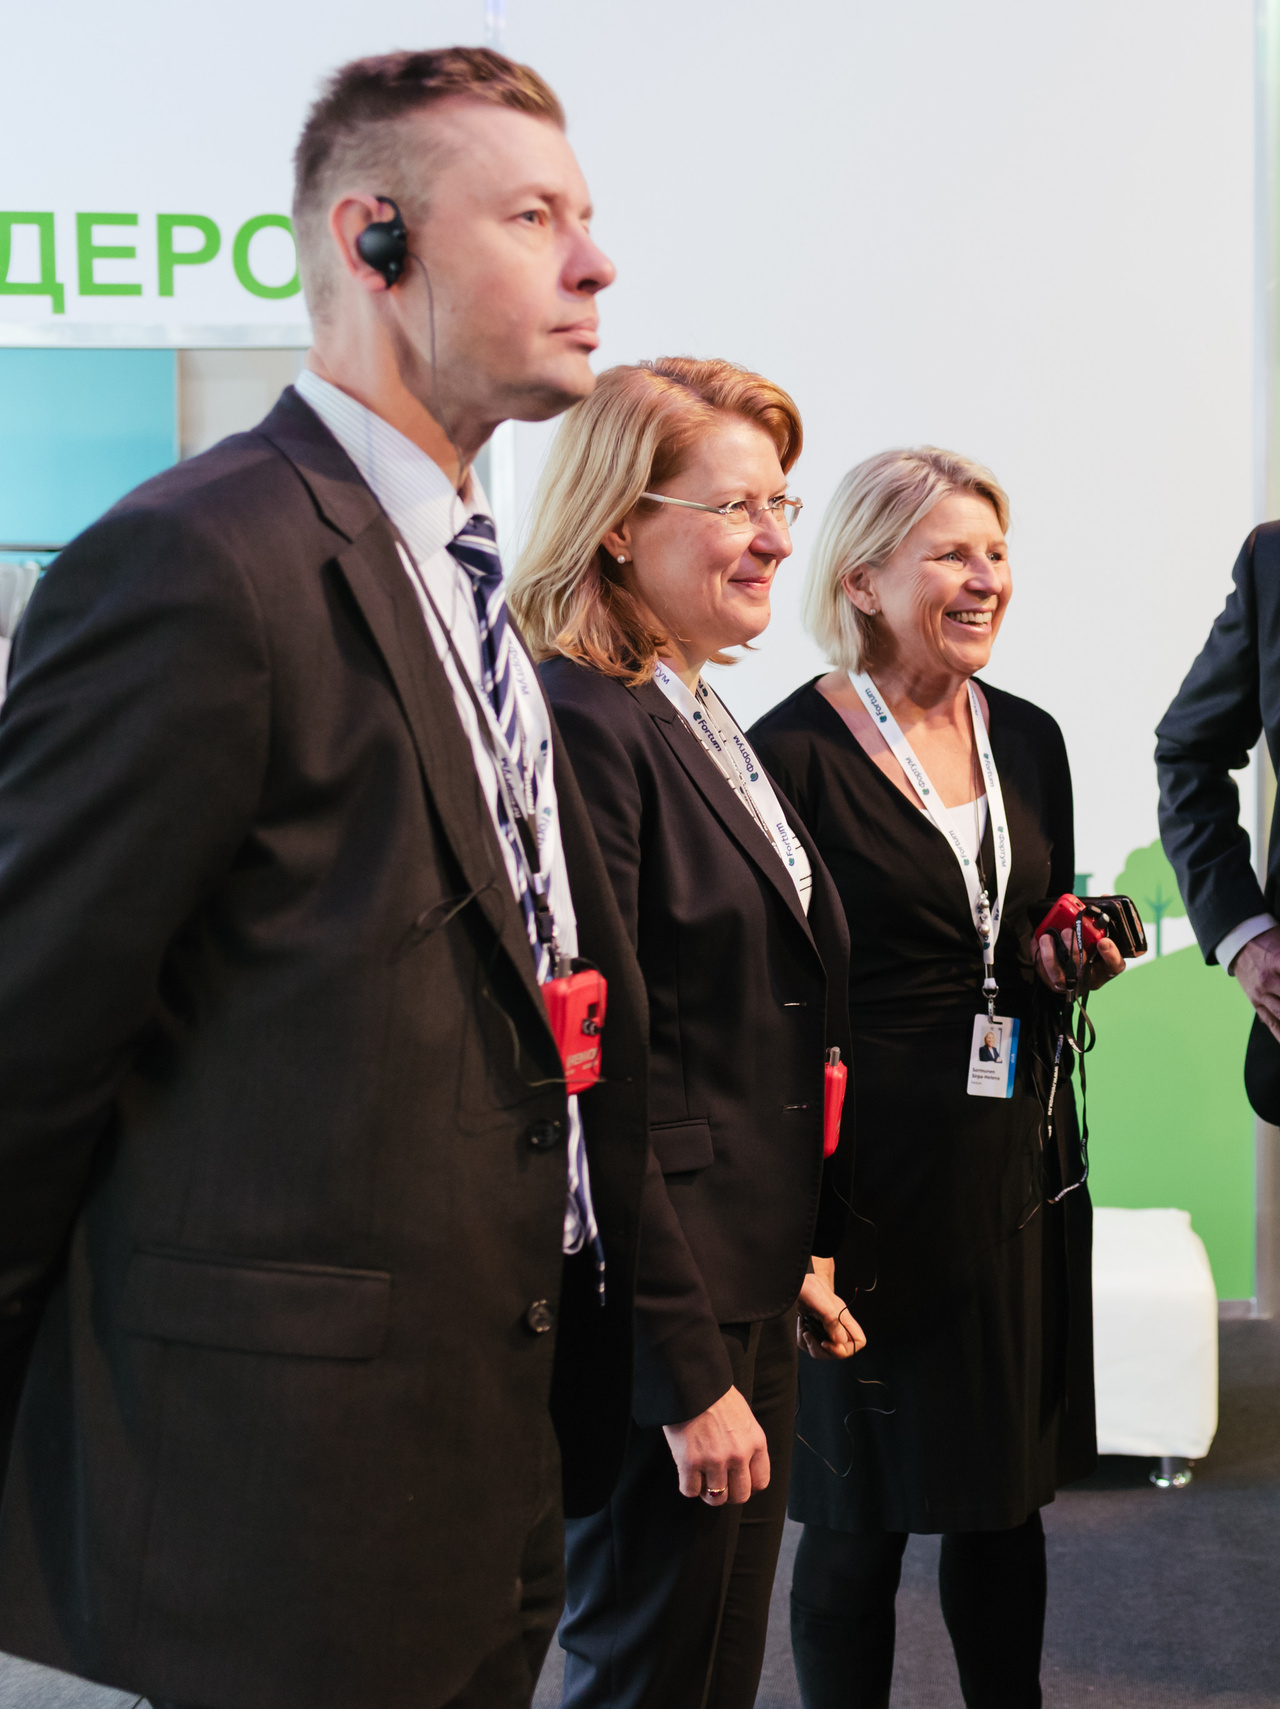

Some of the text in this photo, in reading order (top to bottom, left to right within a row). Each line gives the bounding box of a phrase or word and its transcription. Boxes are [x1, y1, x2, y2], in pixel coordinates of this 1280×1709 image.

[864, 688, 882, 718] Fortum
[698, 718, 722, 753] Fortum
[732, 735, 755, 773] Фортум
[905, 756, 925, 790] Фортум
[776, 822, 793, 857] Fortum
